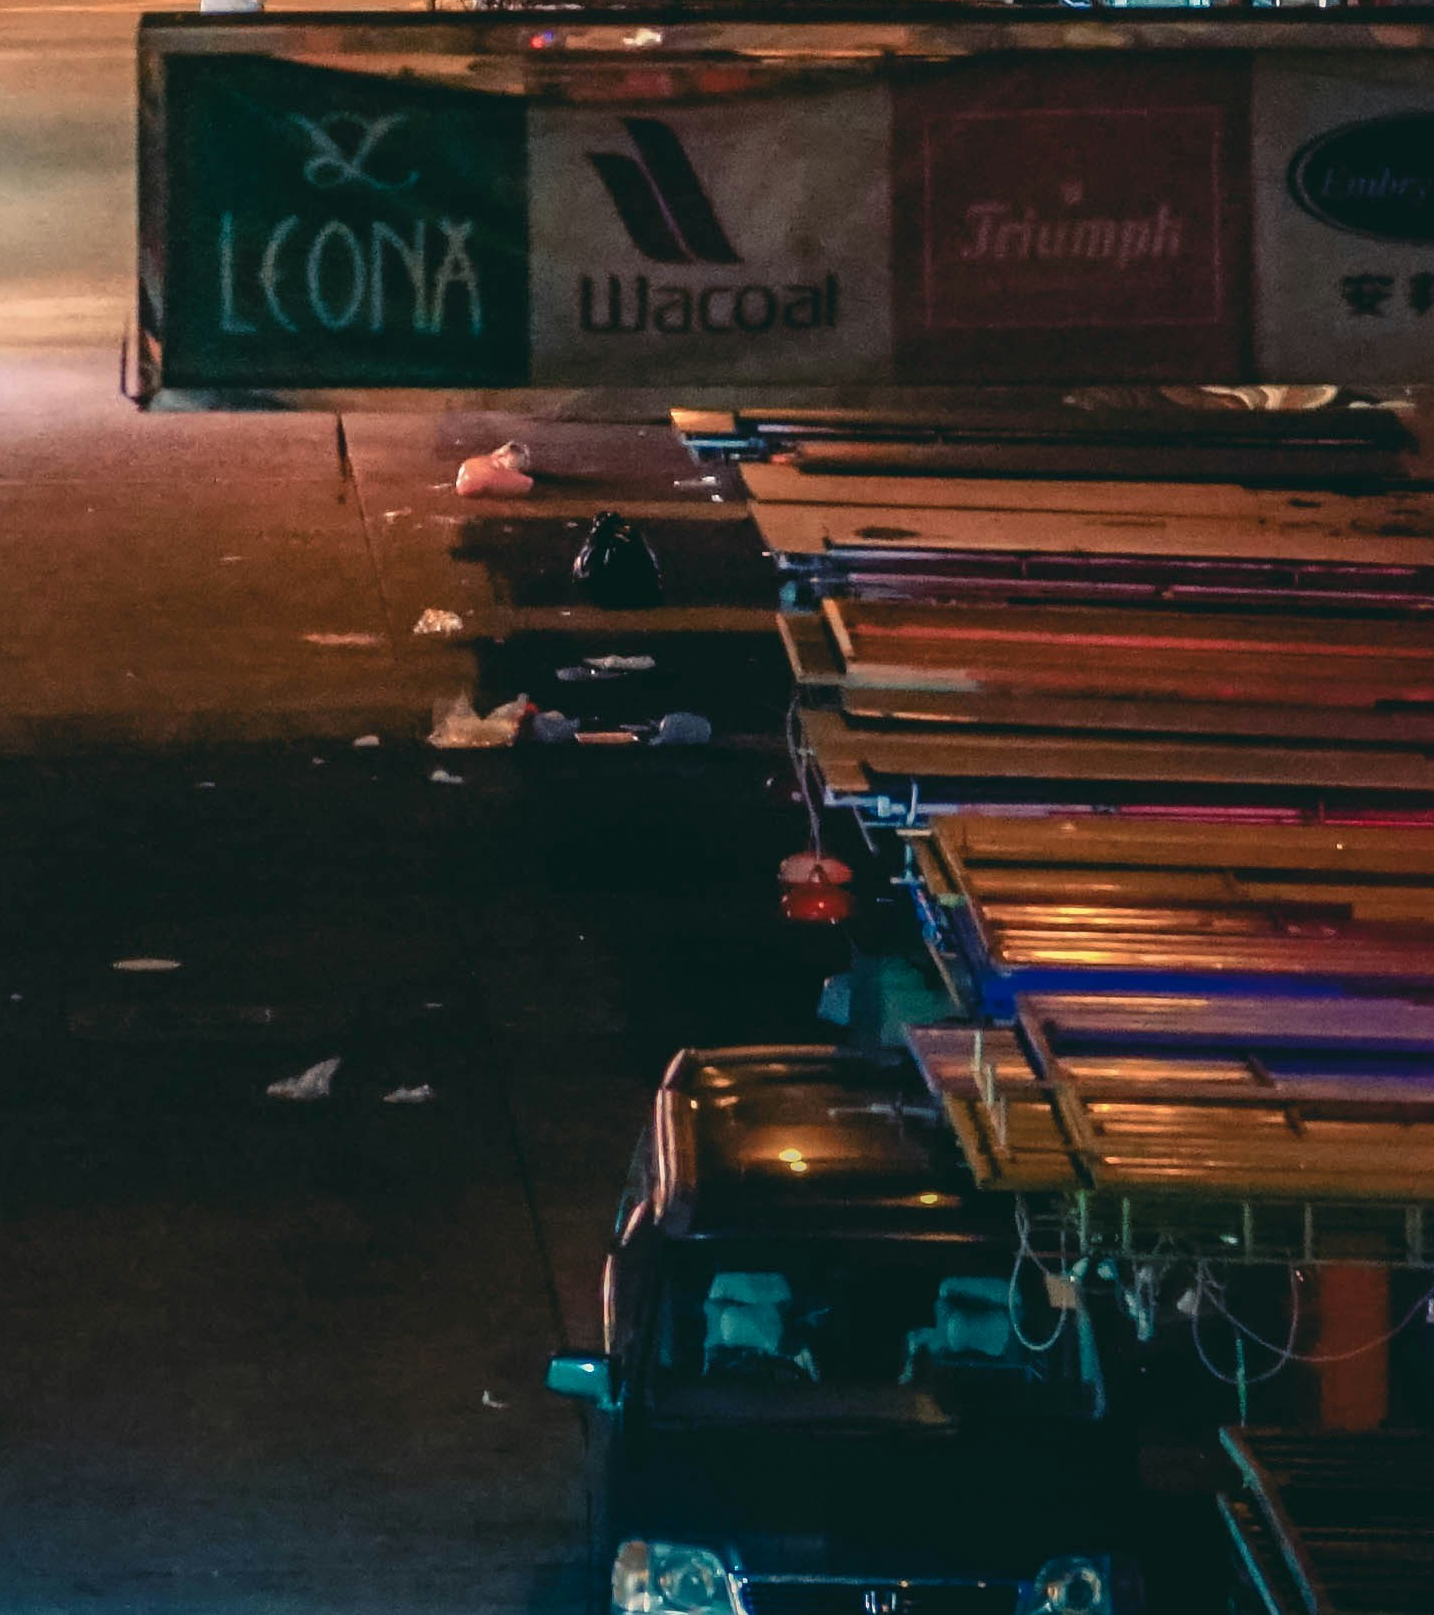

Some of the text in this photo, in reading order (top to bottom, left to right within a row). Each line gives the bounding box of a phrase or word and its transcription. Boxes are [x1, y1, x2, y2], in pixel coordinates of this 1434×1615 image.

[958, 201, 1186, 272] Triumph
[219, 212, 484, 337] LEONA
[580, 273, 836, 336] Wacoal
